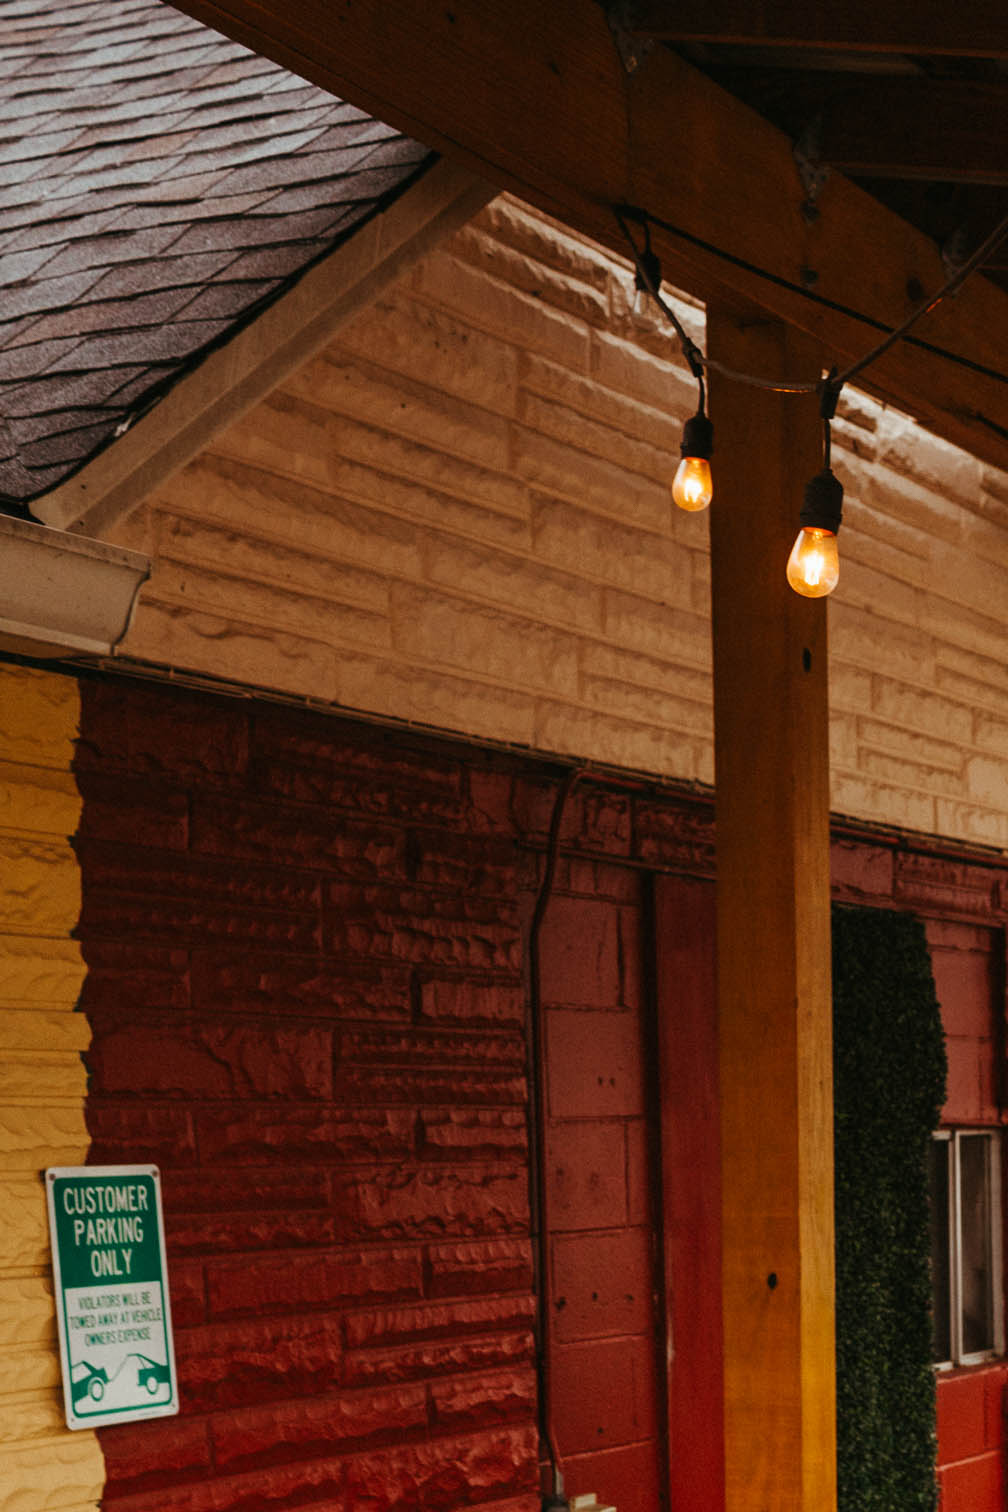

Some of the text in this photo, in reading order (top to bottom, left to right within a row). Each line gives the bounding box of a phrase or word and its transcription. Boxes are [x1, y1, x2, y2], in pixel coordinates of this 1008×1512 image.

[64, 1185, 148, 1215] CUSTOMER
[74, 1216, 143, 1246] PARKING
[91, 1249, 132, 1277] ONLY
[78, 1294, 120, 1310] VIOLATORS
[122, 1293, 139, 1305] WILL
[70, 1307, 161, 1329] TOWED AWAY AT VEHICLE
[119, 1326, 151, 1343] EXPENSE
